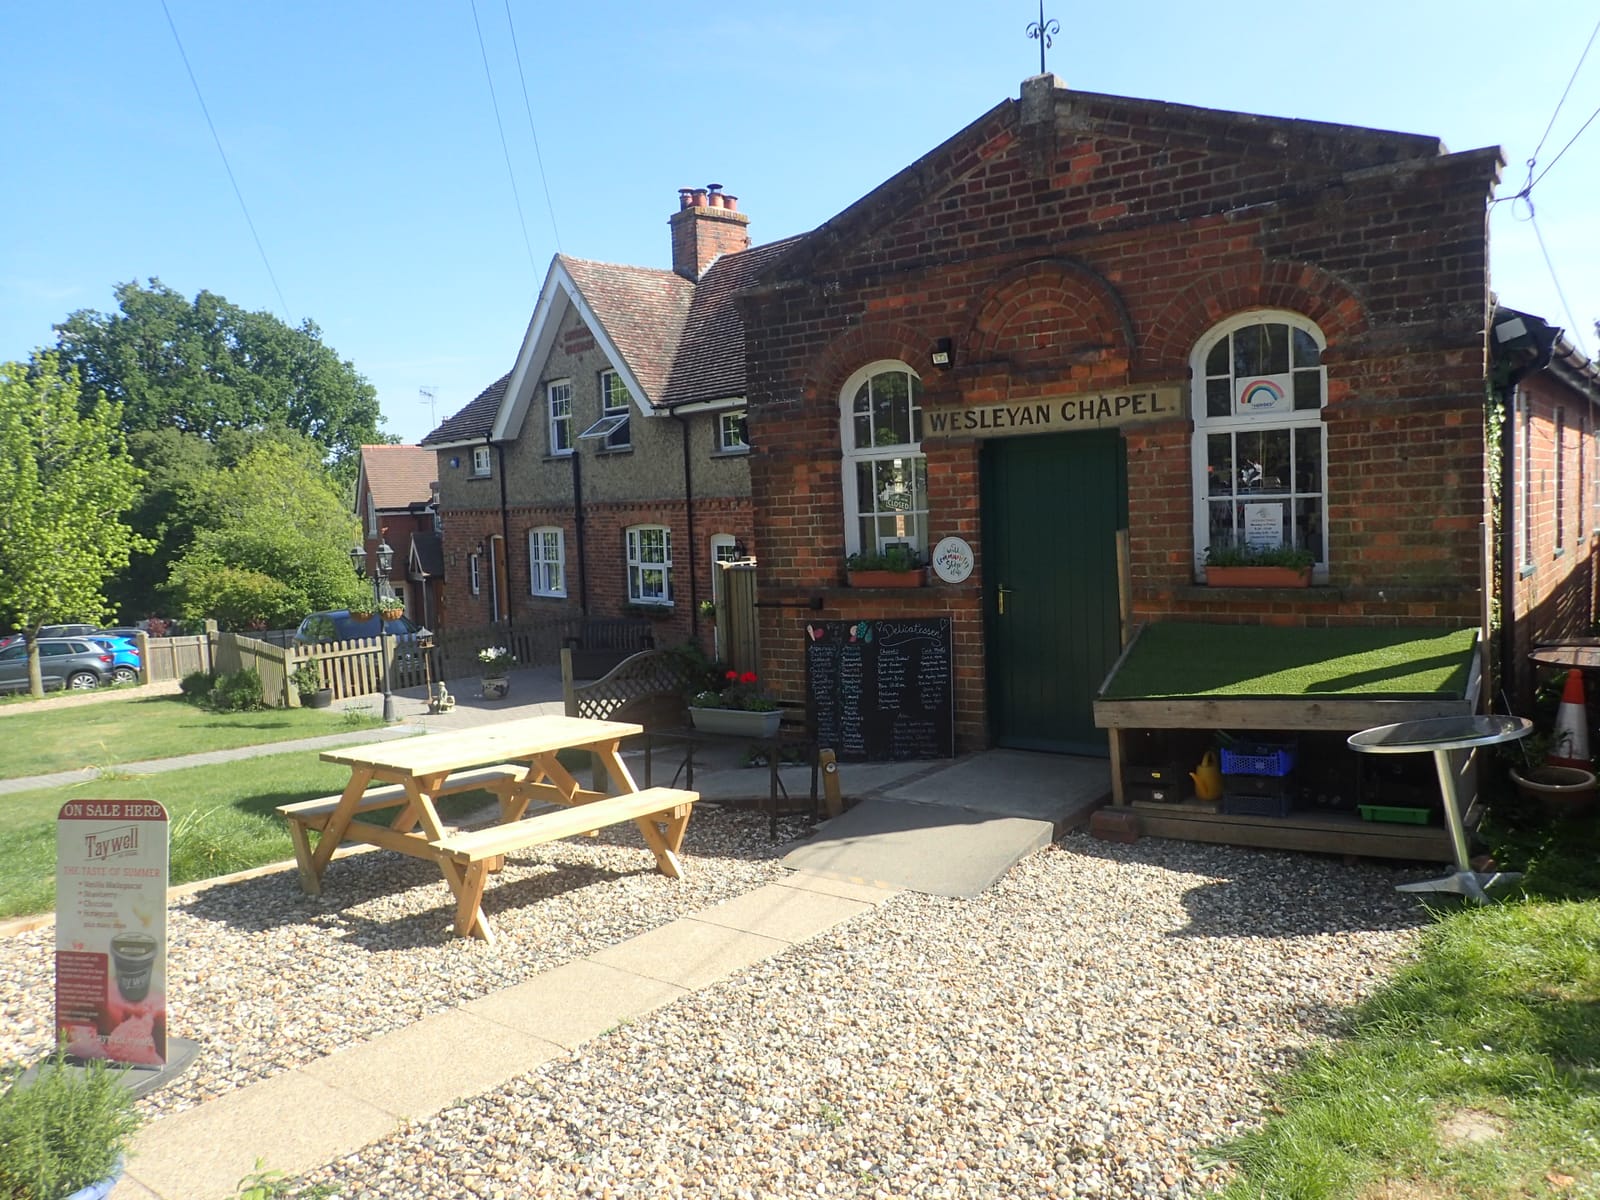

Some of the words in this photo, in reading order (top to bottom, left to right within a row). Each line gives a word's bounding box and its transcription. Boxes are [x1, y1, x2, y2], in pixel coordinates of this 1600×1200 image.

[929, 403, 1051, 432] WESLEYAN
[888, 499, 909, 510] CLOSED
[945, 560, 961, 570] Shop
[64, 804, 83, 816] ON
[86, 804, 121, 817] SALE
[124, 804, 161, 817] HERE
[85, 827, 139, 861] Taywell
[64, 865, 80, 875] THE
[82, 866, 105, 876] TASTE
[109, 867, 121, 876] OF
[123, 867, 161, 877] SUMMER
